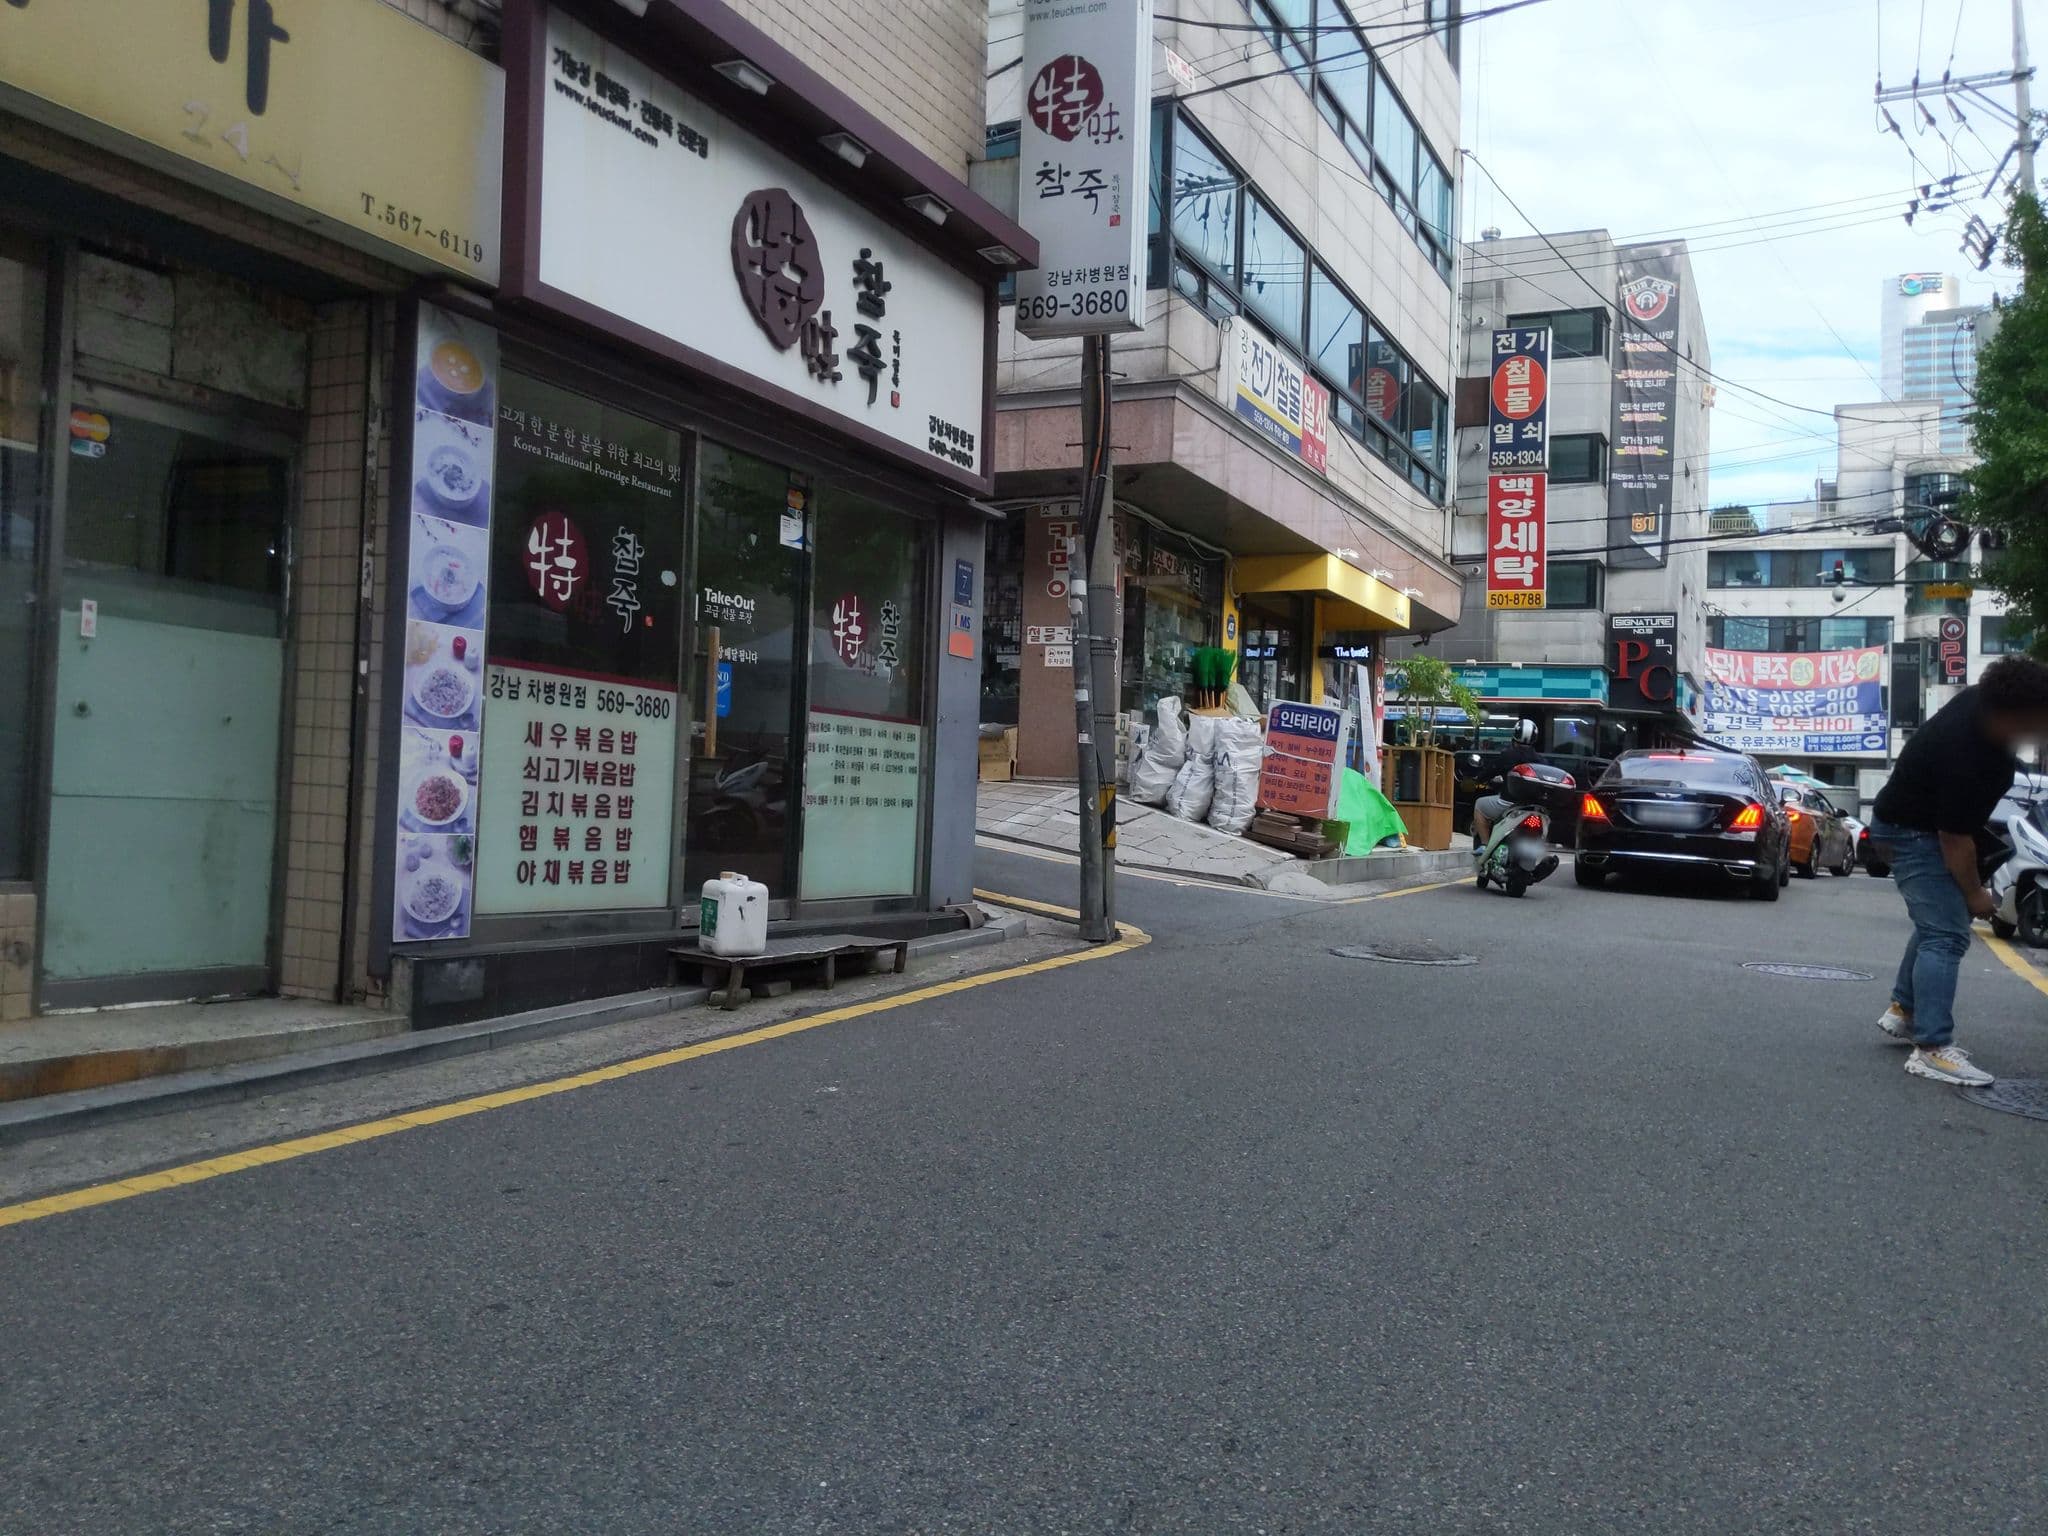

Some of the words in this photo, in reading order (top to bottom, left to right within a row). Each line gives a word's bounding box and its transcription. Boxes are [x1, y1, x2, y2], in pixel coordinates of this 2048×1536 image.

[1035, 161, 1108, 215] 참죽
[1048, 263, 1129, 287] 강남차병원점
[1018, 289, 1128, 320] 569-3680
[847, 248, 891, 406] 참죽
[1496, 331, 1545, 354] 전기
[1505, 358, 1532, 413] 철물
[500, 406, 525, 431] 고객
[530, 416, 541, 437] 한
[548, 423, 559, 442] 분
[564, 427, 576, 448] 한
[580, 434, 603, 457] 분을
[608, 442, 629, 465] 위한
[633, 451, 663, 476] 최고의
[1494, 421, 1542, 444] 열쇠
[513, 436, 541, 456] Korea
[544, 446, 592, 472] Traditional
[595, 464, 630, 486] Porridge
[632, 476, 672, 498] Restaurant
[1491, 450, 1543, 466] 558-1304
[1494, 477, 1539, 588] 백양세탁
[1632, 512, 1656, 533] B1
[528, 518, 581, 601] 特
[607, 526, 645, 633] 참죽
[704, 588, 755, 611] Take-Out
[1490, 591, 1542, 606] 501-8788
[704, 604, 720, 618] 고급
[721, 608, 736, 621] 선물
[739, 611, 752, 625] 포장
[1616, 618, 1671, 626] SIGNATURE
[878, 600, 900, 683] 참죽
[1335, 647, 1350, 657] The
[1616, 640, 1673, 700] PC
[1940, 642, 1966, 676] PC
[491, 674, 521, 700] 강남
[527, 679, 587, 709] 차병원점
[597, 689, 670, 719] 569-3680
[1281, 711, 1337, 735] 인테리어
[1725, 716, 1763, 731] 경복
[1771, 717, 1853, 732] 오토바이
[524, 721, 638, 755] 새우볶음밥
[1742, 735, 1801, 748] 유료주차장
[523, 756, 636, 787] 쇠고기볶음밥
[522, 791, 634, 819] 김치볶음밥
[516, 859, 631, 886] 야채볶음밥
